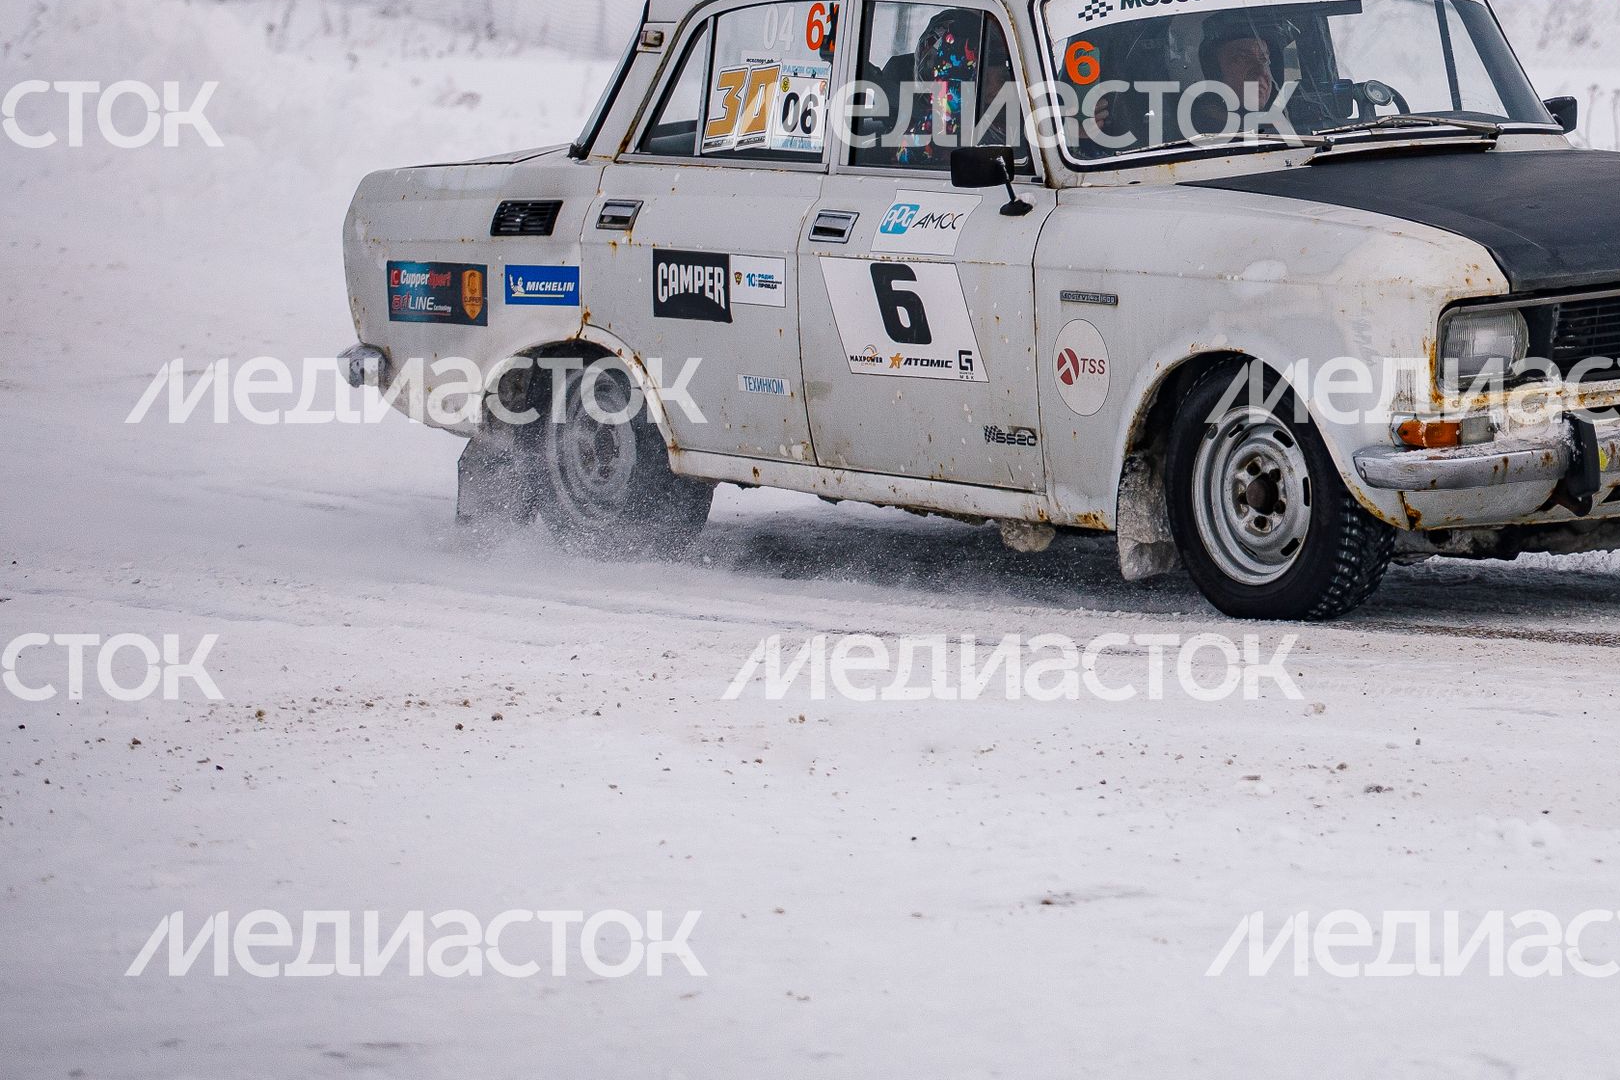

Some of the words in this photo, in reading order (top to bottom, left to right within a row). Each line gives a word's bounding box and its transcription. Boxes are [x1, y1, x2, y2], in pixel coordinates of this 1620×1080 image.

[806, 2, 826, 51] 6
[1065, 40, 1102, 85] 6
[781, 91, 820, 135] 06
[882, 204, 918, 232] PPG
[526, 281, 575, 292] MICHELIN
[657, 262, 726, 310] CAMPER
[870, 262, 933, 345] 6
[849, 354, 883, 364] MAXPOWER
[903, 357, 953, 369] ATOMIC
[1080, 358, 1106, 375] TSS
[743, 376, 785, 395] ТЕХИНКОМ
